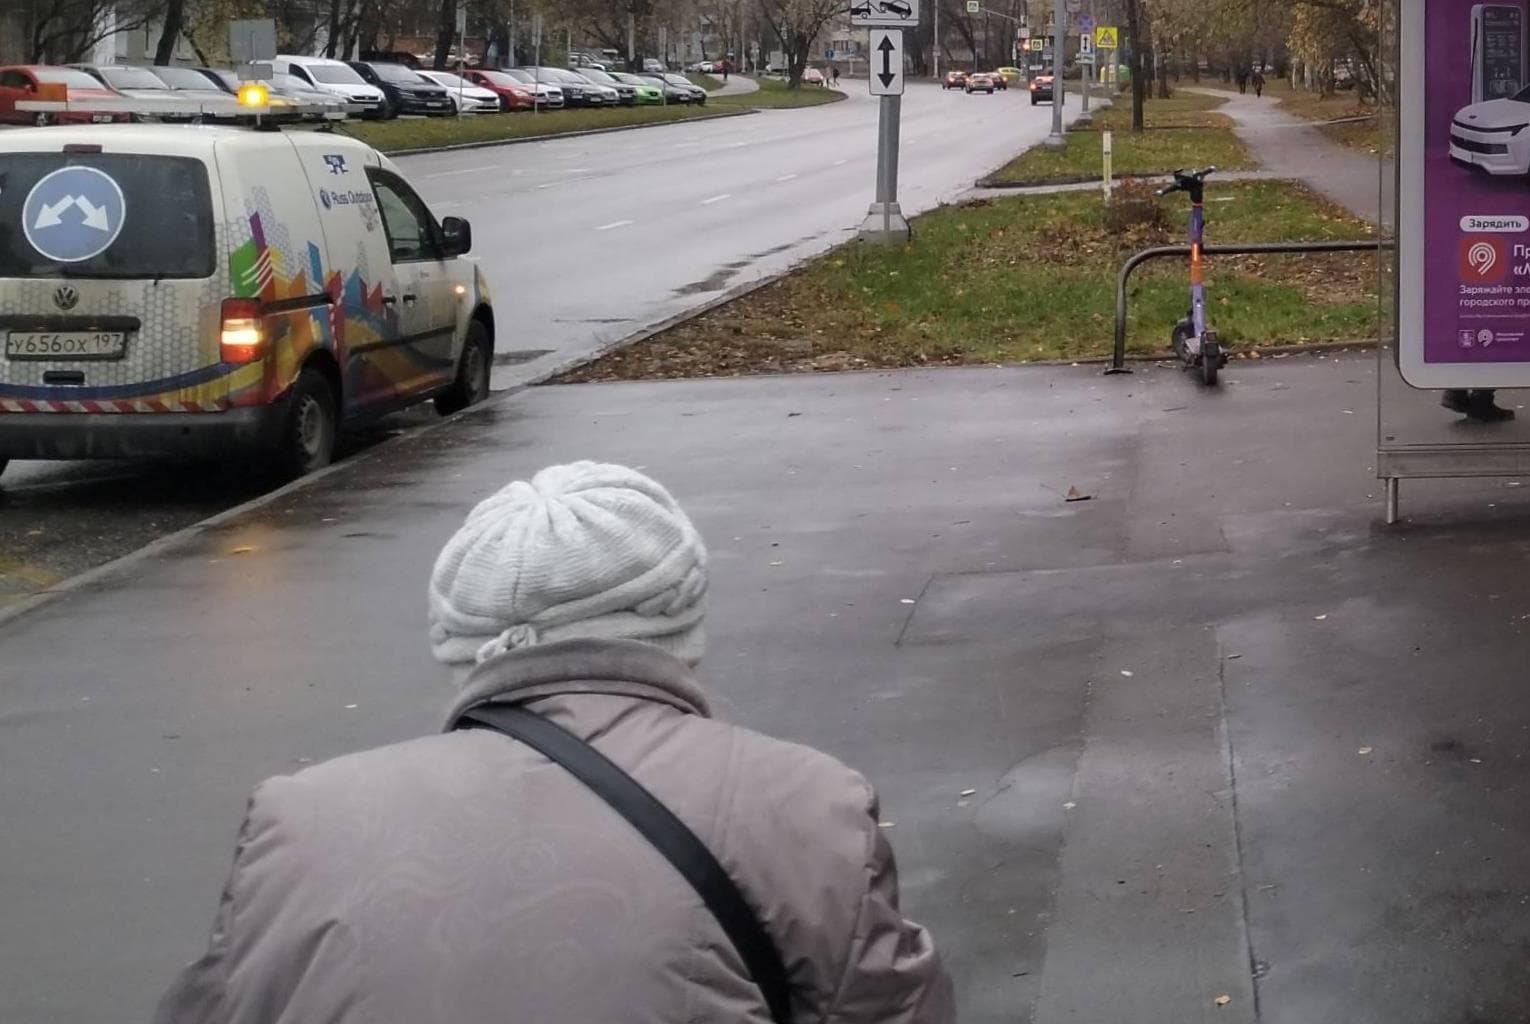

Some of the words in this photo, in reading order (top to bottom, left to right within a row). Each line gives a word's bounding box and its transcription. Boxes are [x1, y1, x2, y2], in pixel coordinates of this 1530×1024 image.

[1469, 218, 1522, 230] Зарядить
[1459, 284, 1513, 295] Заряжайте
[1459, 296, 1515, 307] городского
